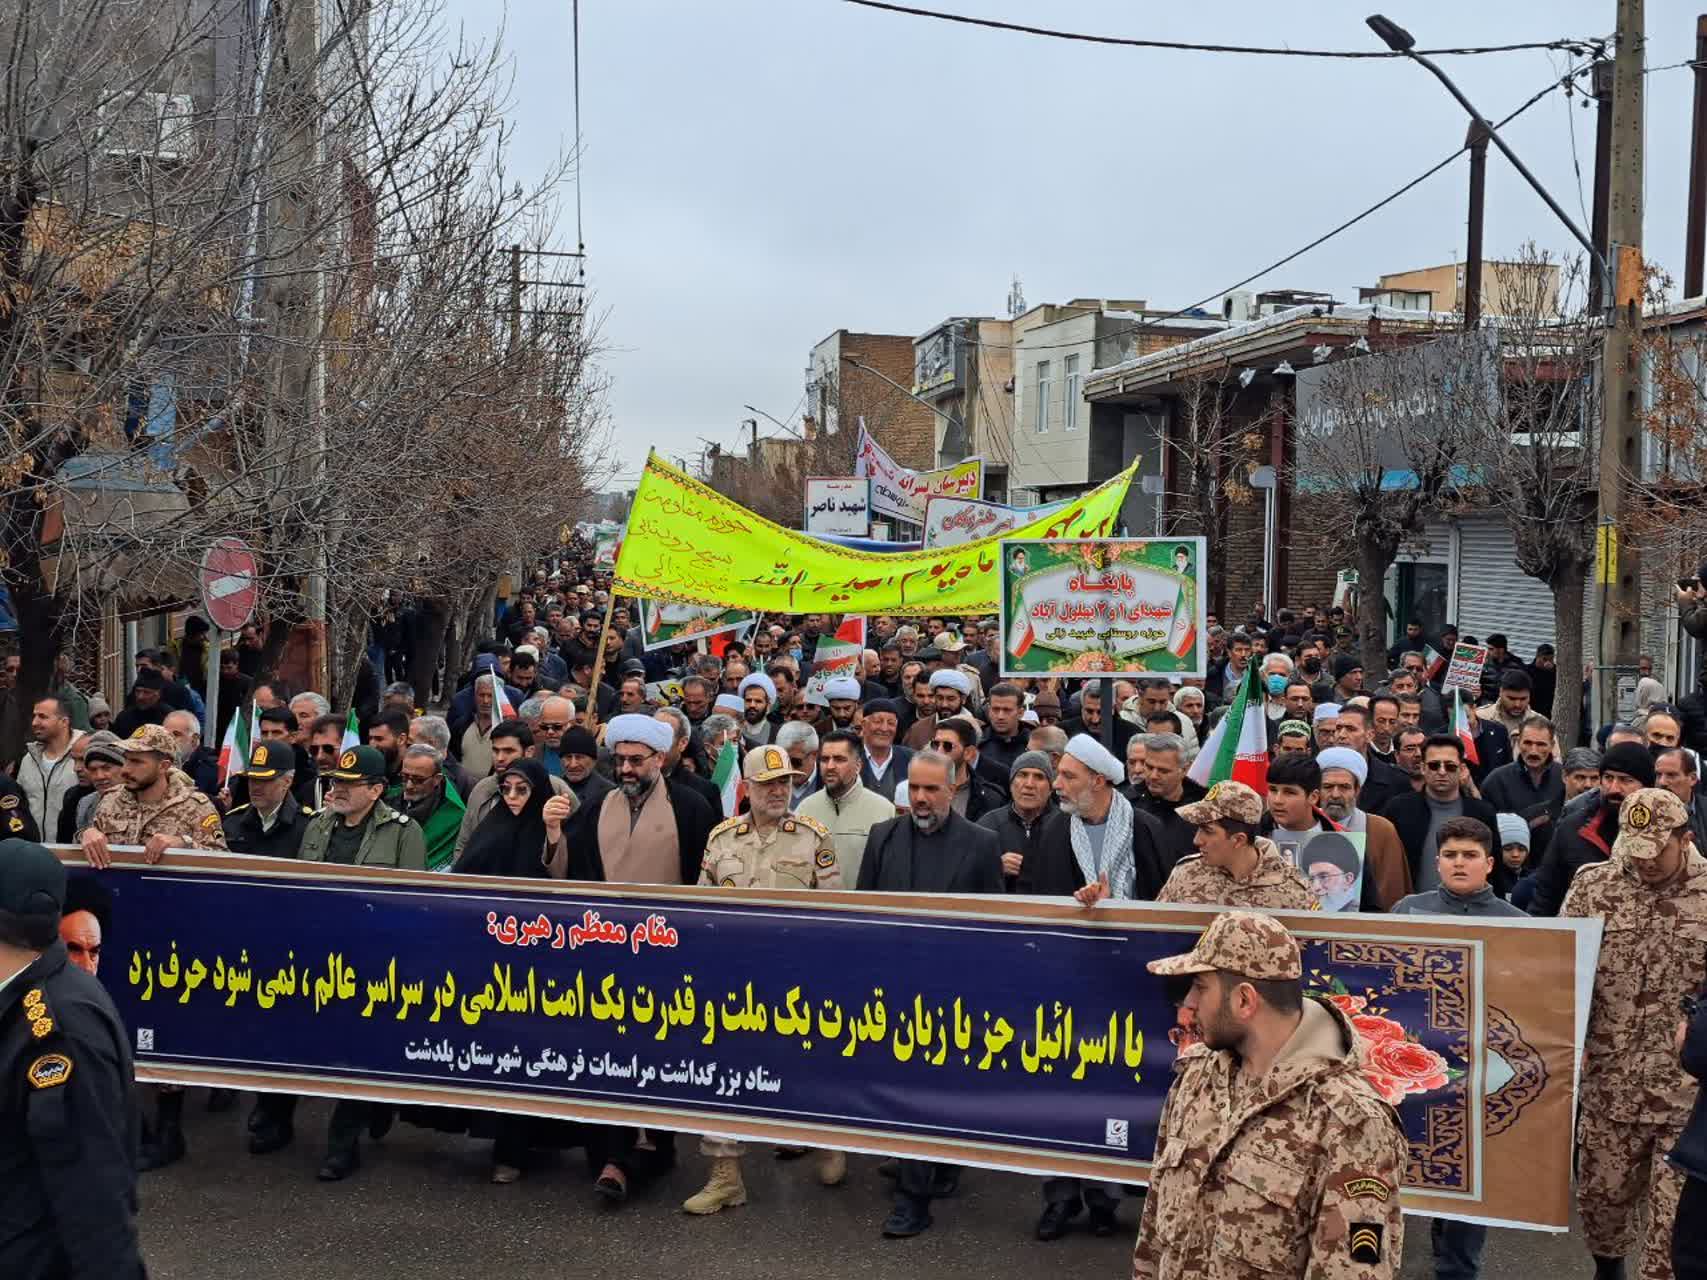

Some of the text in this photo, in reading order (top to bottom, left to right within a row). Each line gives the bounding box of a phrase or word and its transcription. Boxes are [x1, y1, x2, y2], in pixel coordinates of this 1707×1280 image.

[810, 496, 867, 517] شهید ناصر
[1031, 601, 1057, 620] آباد
[1068, 571, 1136, 598] پایگاه
[1108, 606, 1117, 622] و
[1127, 600, 1173, 623] شهدای
[1068, 627, 1096, 640] شهید
[1140, 628, 1166, 640] حوزه
[487, 910, 678, 954] مقام معظم رهبری:
[128, 950, 153, 1001] زد
[158, 939, 208, 1004] حرف
[213, 948, 252, 1008] شود
[256, 950, 296, 1009] نمی
[361, 955, 424, 1020] سراسر
[429, 970, 456, 1023] در
[460, 961, 536, 1025] اسلامی
[542, 968, 584, 1018] امت
[590, 973, 626, 1035] یک
[632, 974, 696, 1041] قدرت
[701, 1000, 715, 1045] و
[721, 981, 768, 1032] ملت
[774, 985, 811, 1050] یک
[818, 987, 887, 1057] قدرت
[893, 993, 947, 1065] زبان
[953, 996, 971, 1066] با
[404, 1037, 782, 1097] ستاد بزرگداشت مراسمات فرهنگی شهرستان پلدشت
[978, 1010, 1015, 1071] جز
[1021, 1000, 1117, 1080] اسرائیل
[1124, 1011, 1144, 1083] با
